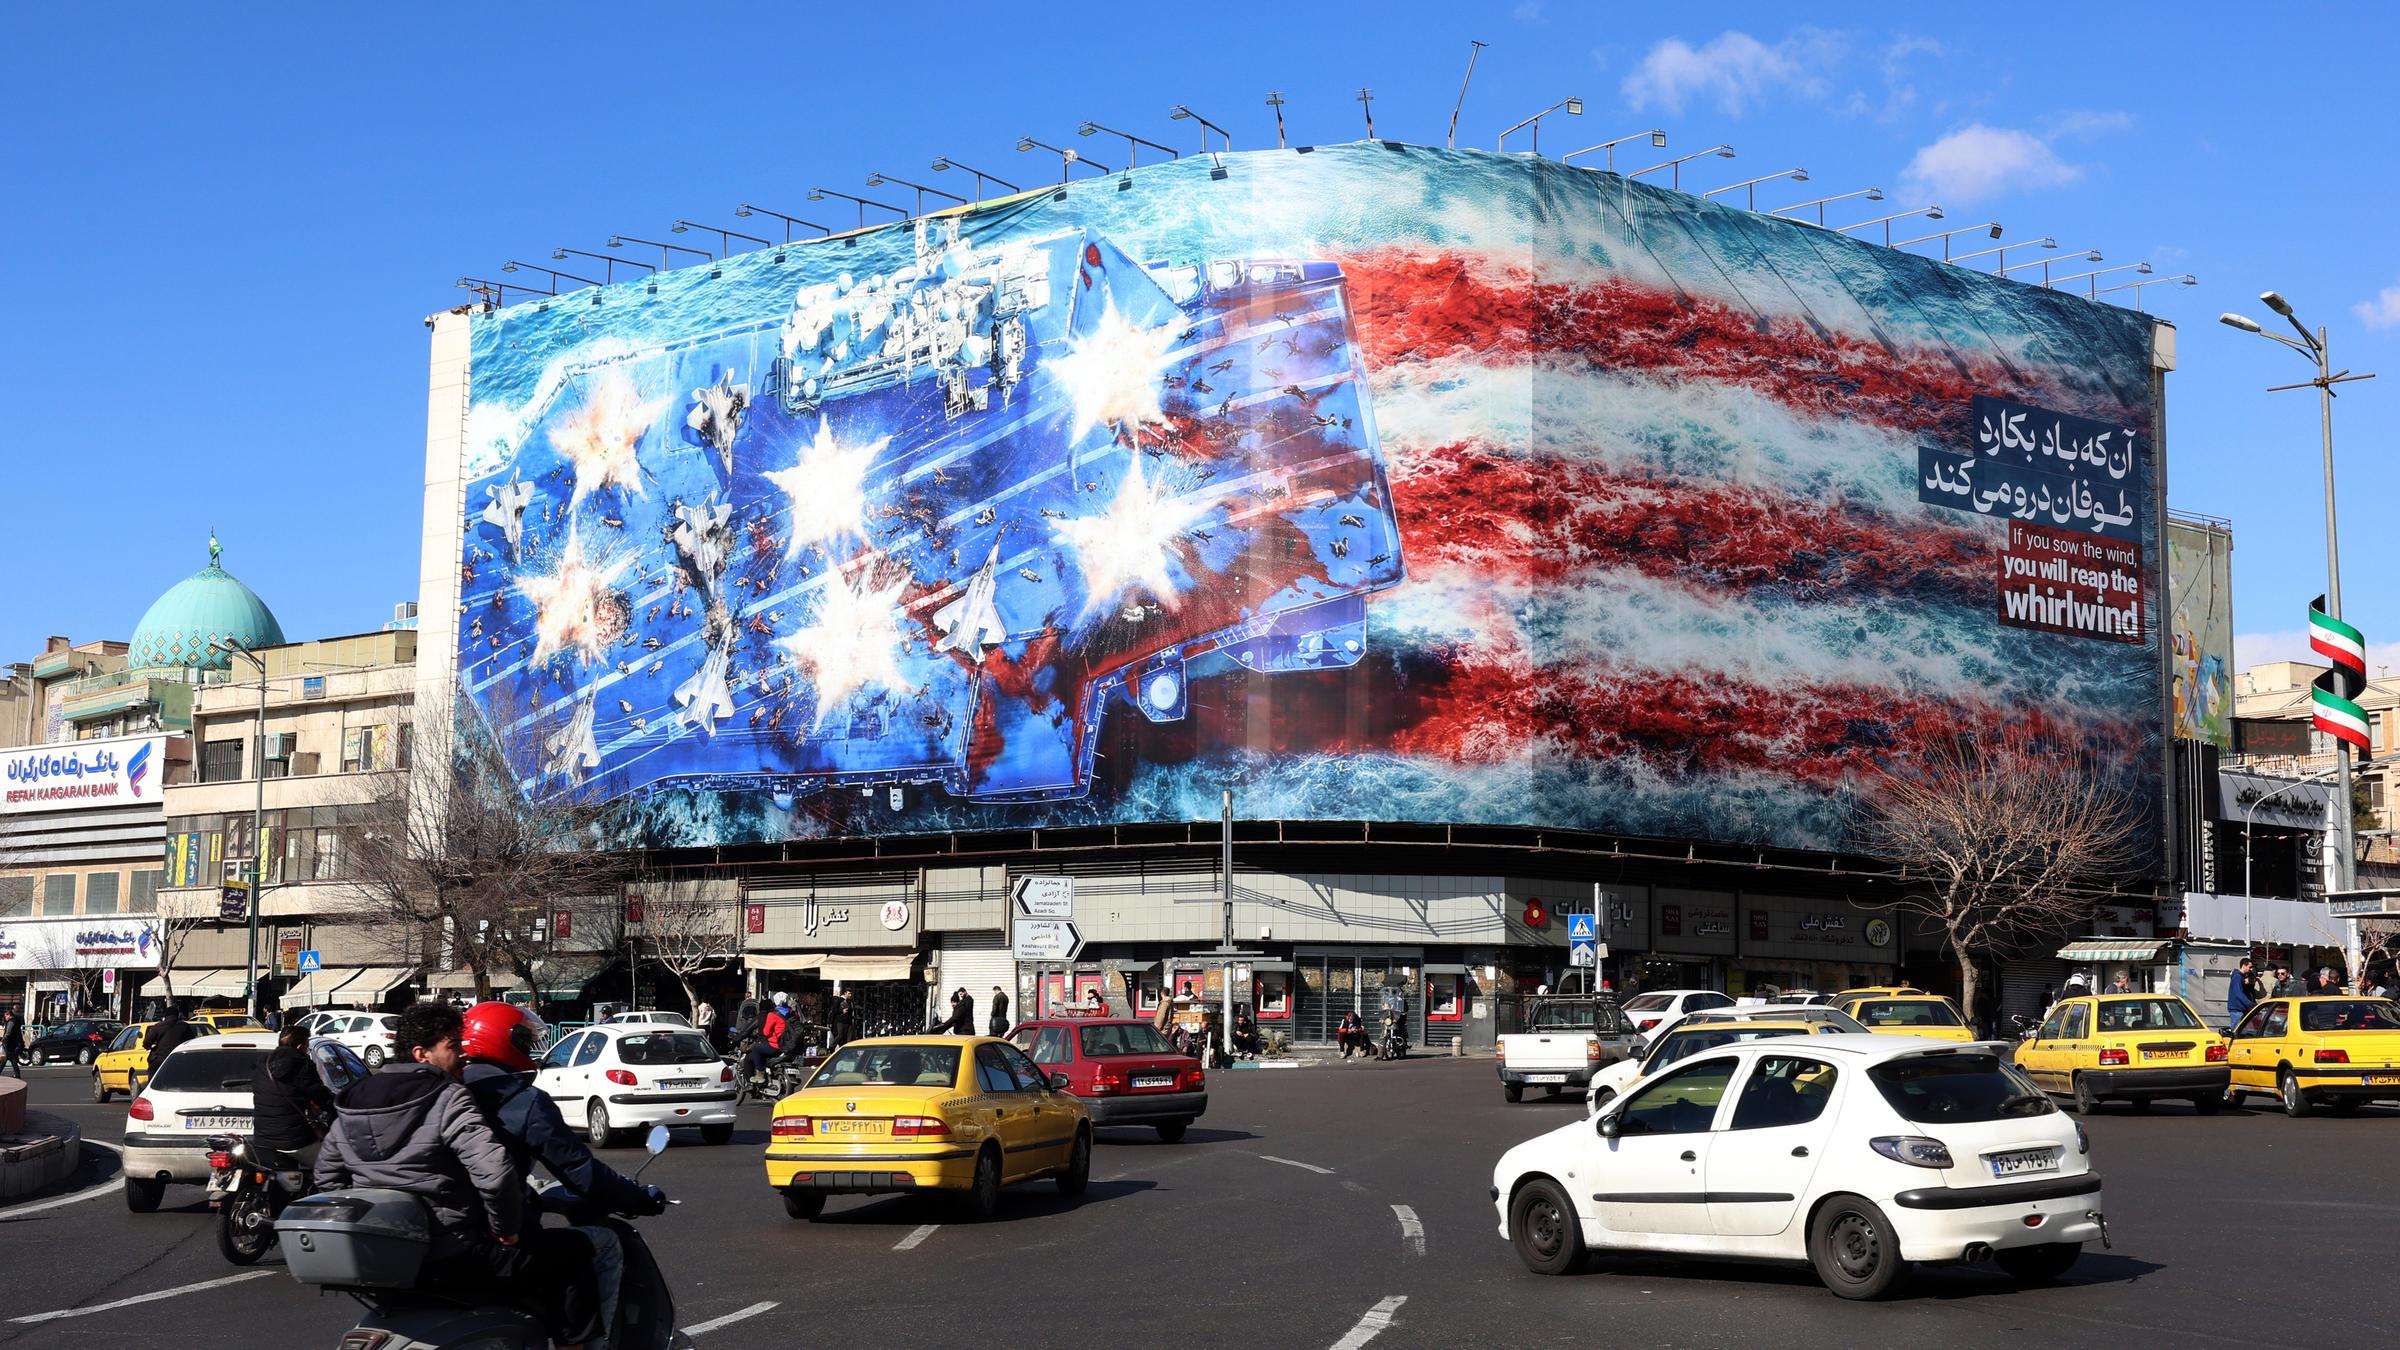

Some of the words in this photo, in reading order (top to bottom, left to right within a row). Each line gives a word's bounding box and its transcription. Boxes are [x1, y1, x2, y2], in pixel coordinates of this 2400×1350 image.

[1980, 409, 2036, 463] بکارد
[2041, 420, 2078, 472] باد
[2051, 479, 2134, 533] طوفان
[2013, 528, 2022, 545] If
[2026, 532, 2050, 551] you
[2053, 539, 2079, 555] sow
[2082, 541, 2102, 559] the
[2105, 545, 2138, 569] wind,
[2003, 555, 2036, 579] you
[2039, 558, 2068, 583] will
[2071, 566, 2108, 594] reap
[2111, 569, 2138, 594] the
[2004, 583, 2139, 638] whirlwind
[8, 754, 51, 783] کارگران
[51, 751, 83, 778] رفاه
[85, 749, 119, 778] بانک
[6, 789, 36, 803] REFAH
[37, 784, 90, 801] KARGARAN
[91, 782, 119, 797] BANK
[2203, 820, 2215, 893] SAMSUNG
[223, 898, 246, 908] ترجمه
[228, 888, 243, 898] دفتر
[222, 908, 244, 918] رسمی
[822, 907, 848, 926] کفش
[2331, 901, 2354, 913] POLICE
[1696, 922, 1730, 936] ساعتی
[1801, 914, 1819, 929] ملی
[1820, 912, 1845, 931] کفش
